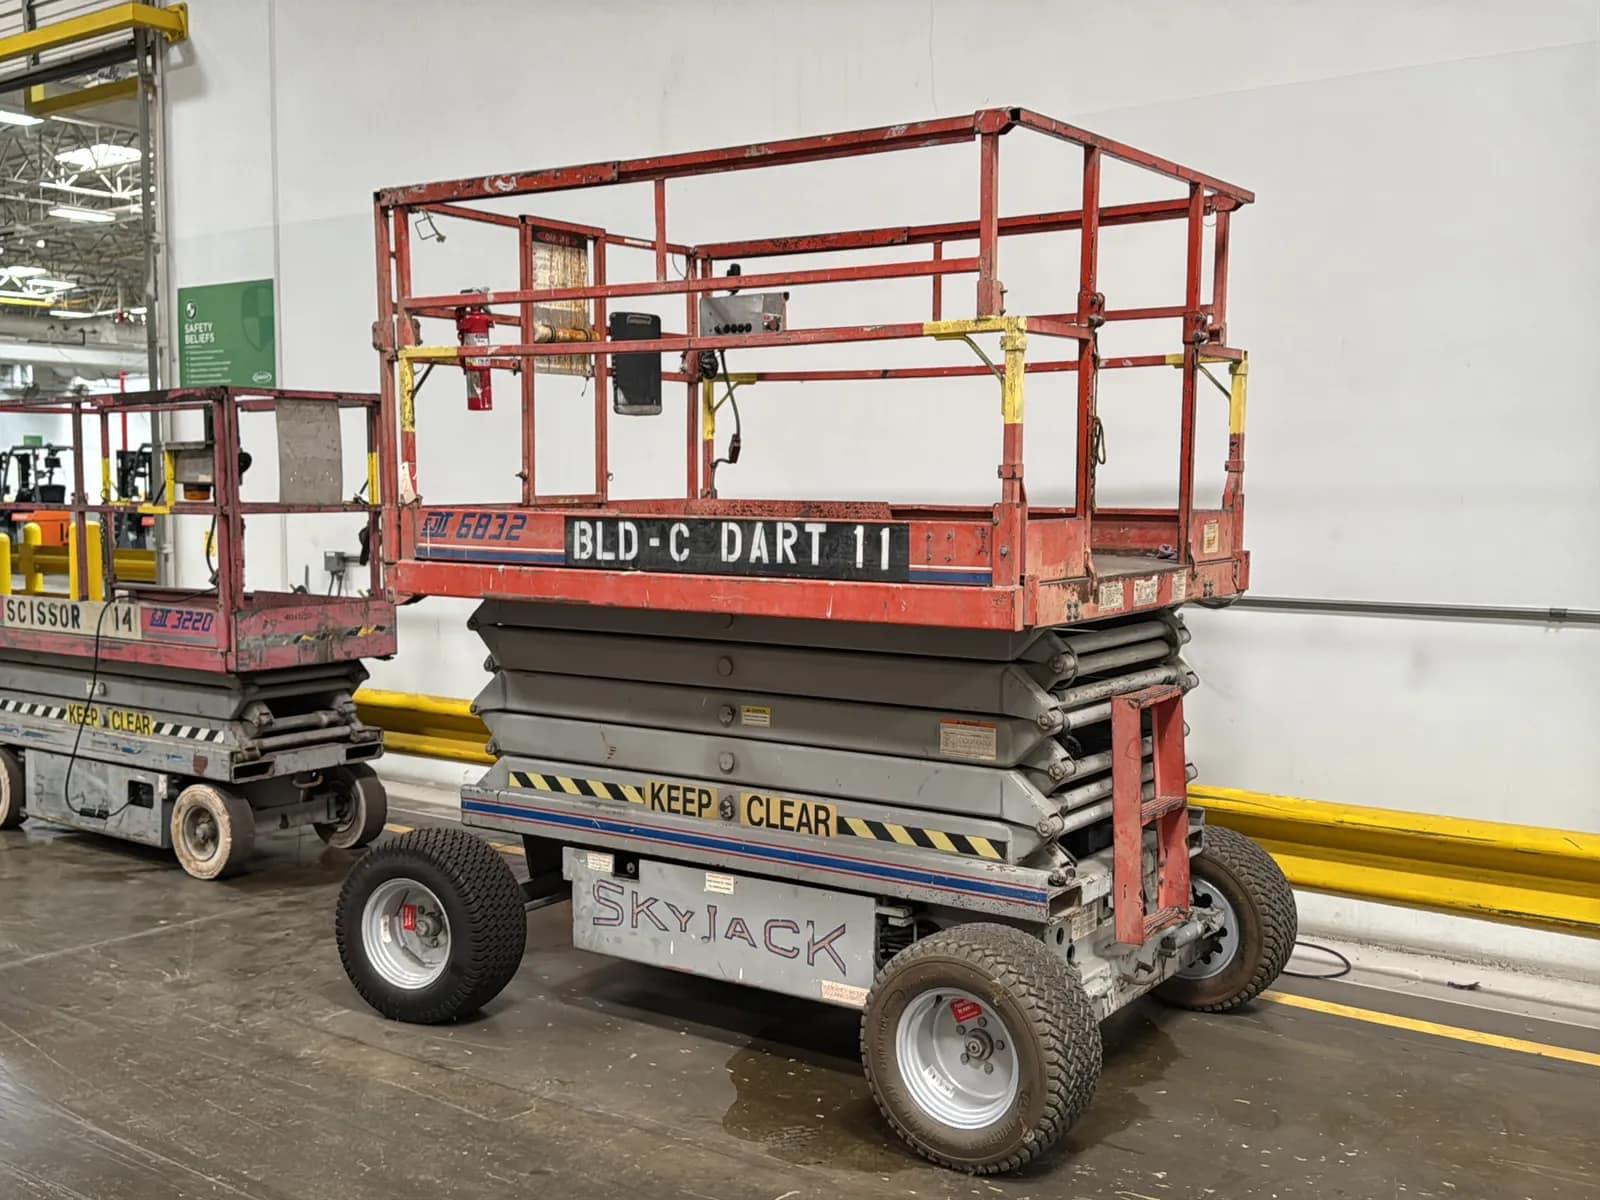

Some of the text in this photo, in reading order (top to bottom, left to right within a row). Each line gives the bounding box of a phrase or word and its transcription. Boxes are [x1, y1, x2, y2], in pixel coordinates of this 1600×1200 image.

[184, 322, 213, 333] SAFETY
[184, 332, 215, 345] BELIEFS
[456, 512, 528, 541] 6832
[721, 522, 827, 566] DART
[853, 525, 890, 571] 11
[6, 599, 132, 632] SCISSOR 14
[171, 610, 214, 632] 3220
[68, 704, 151, 736] KEEP CLEAR
[650, 782, 831, 838] KEEP CLEAR
[592, 879, 847, 977] SKYJACK
